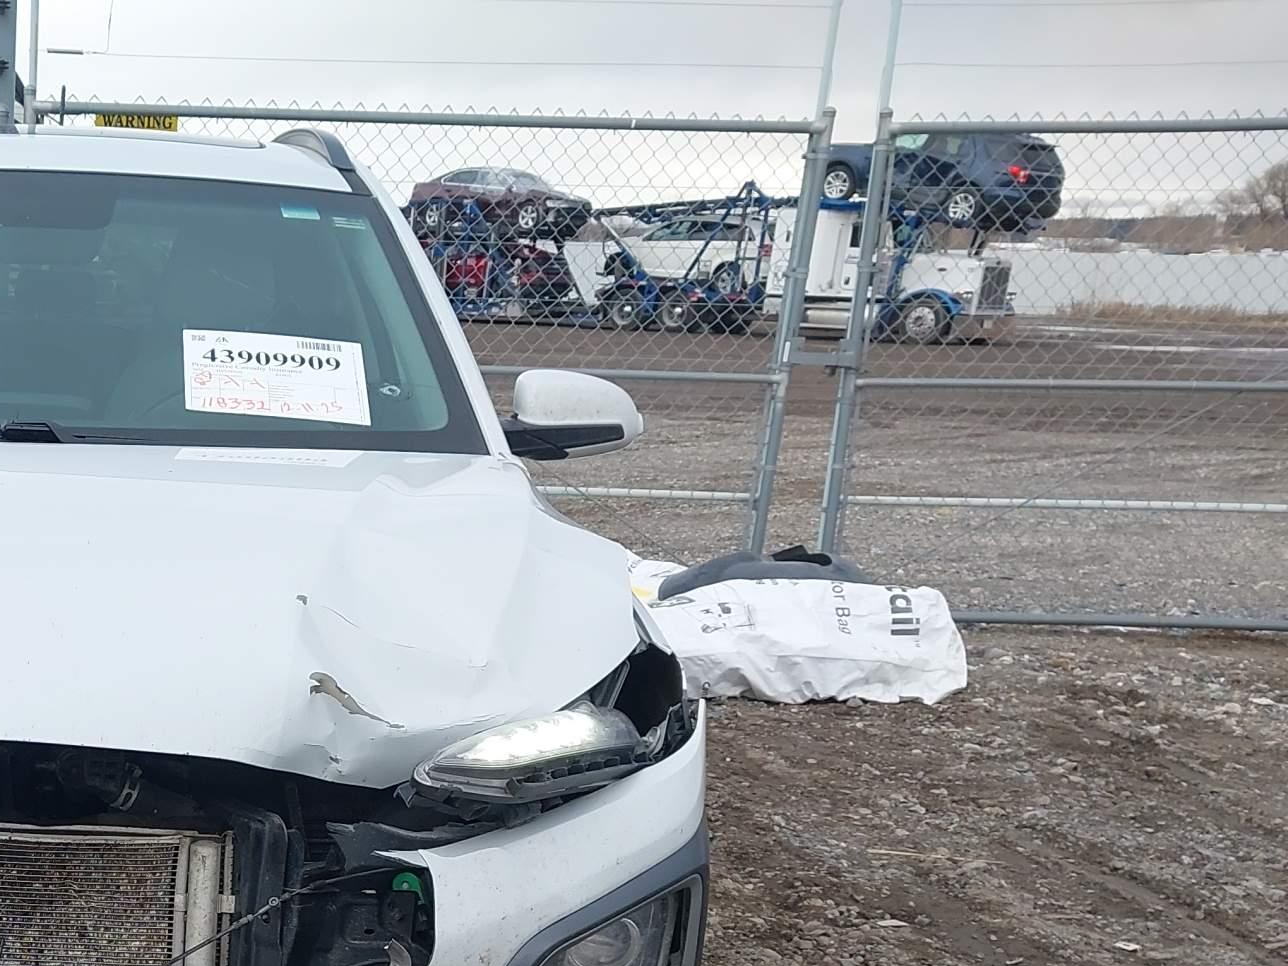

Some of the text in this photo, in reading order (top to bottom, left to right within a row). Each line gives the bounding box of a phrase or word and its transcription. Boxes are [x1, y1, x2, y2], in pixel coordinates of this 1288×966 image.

[103, 114, 173, 129] WARNING
[202, 348, 341, 372] 43909909
[835, 606, 852, 635] Bag
